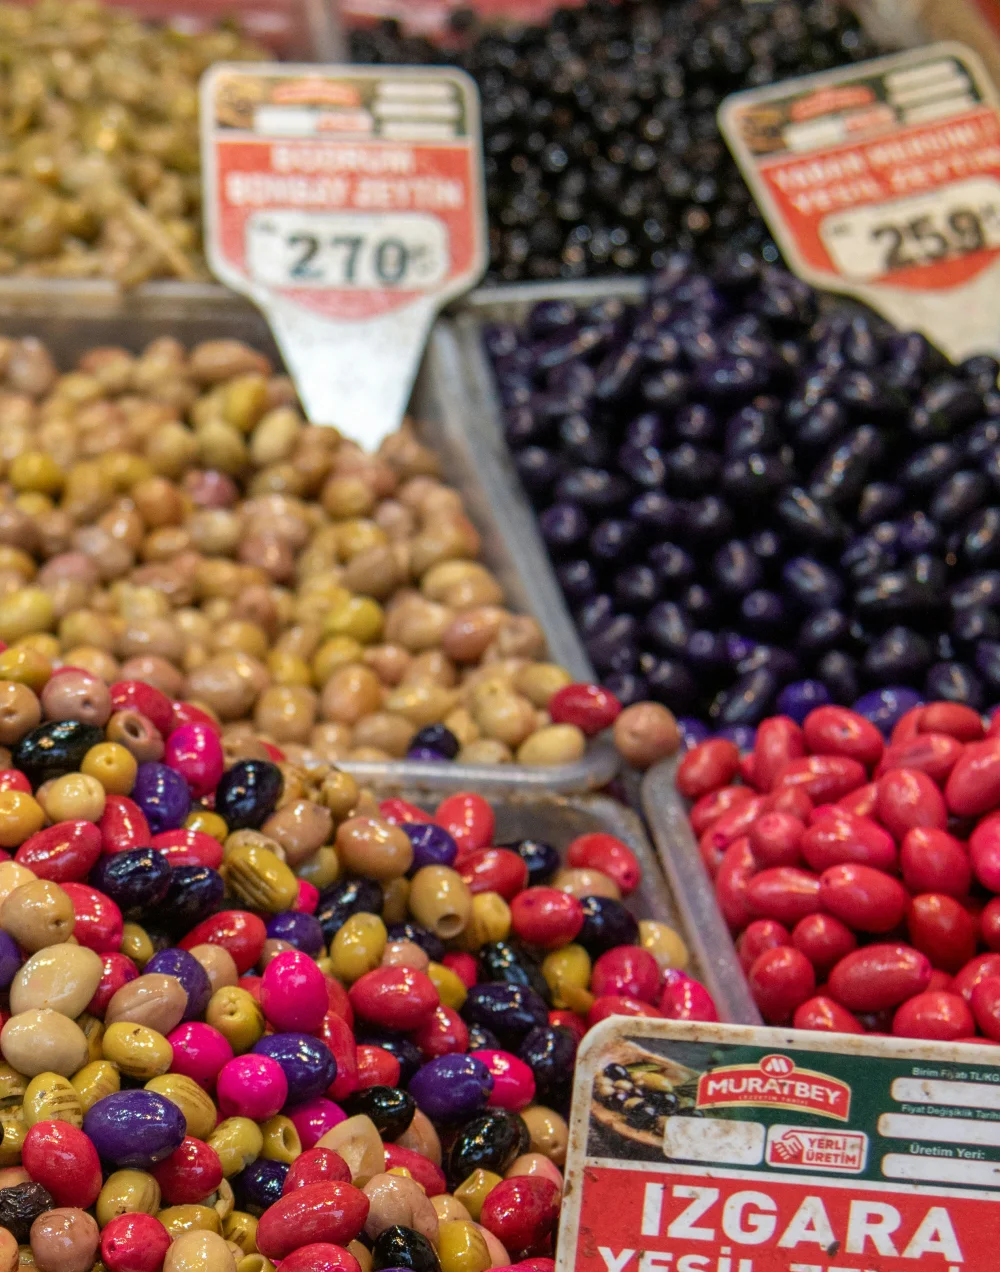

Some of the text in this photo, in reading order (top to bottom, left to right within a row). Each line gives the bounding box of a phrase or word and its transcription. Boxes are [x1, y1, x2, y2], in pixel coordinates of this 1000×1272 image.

[871, 211, 986, 272] 259
[287, 231, 410, 285] 270
[912, 1067, 938, 1077] Birim
[707, 1078, 841, 1105] MURATBEY
[901, 1104, 925, 1114] Fiyat
[808, 1137, 847, 1151] YERLİ
[909, 1142, 986, 1160] Üretim Yeri:
[806, 1149, 857, 1165] ÜRETİM
[640, 1181, 965, 1263] IZGARA
